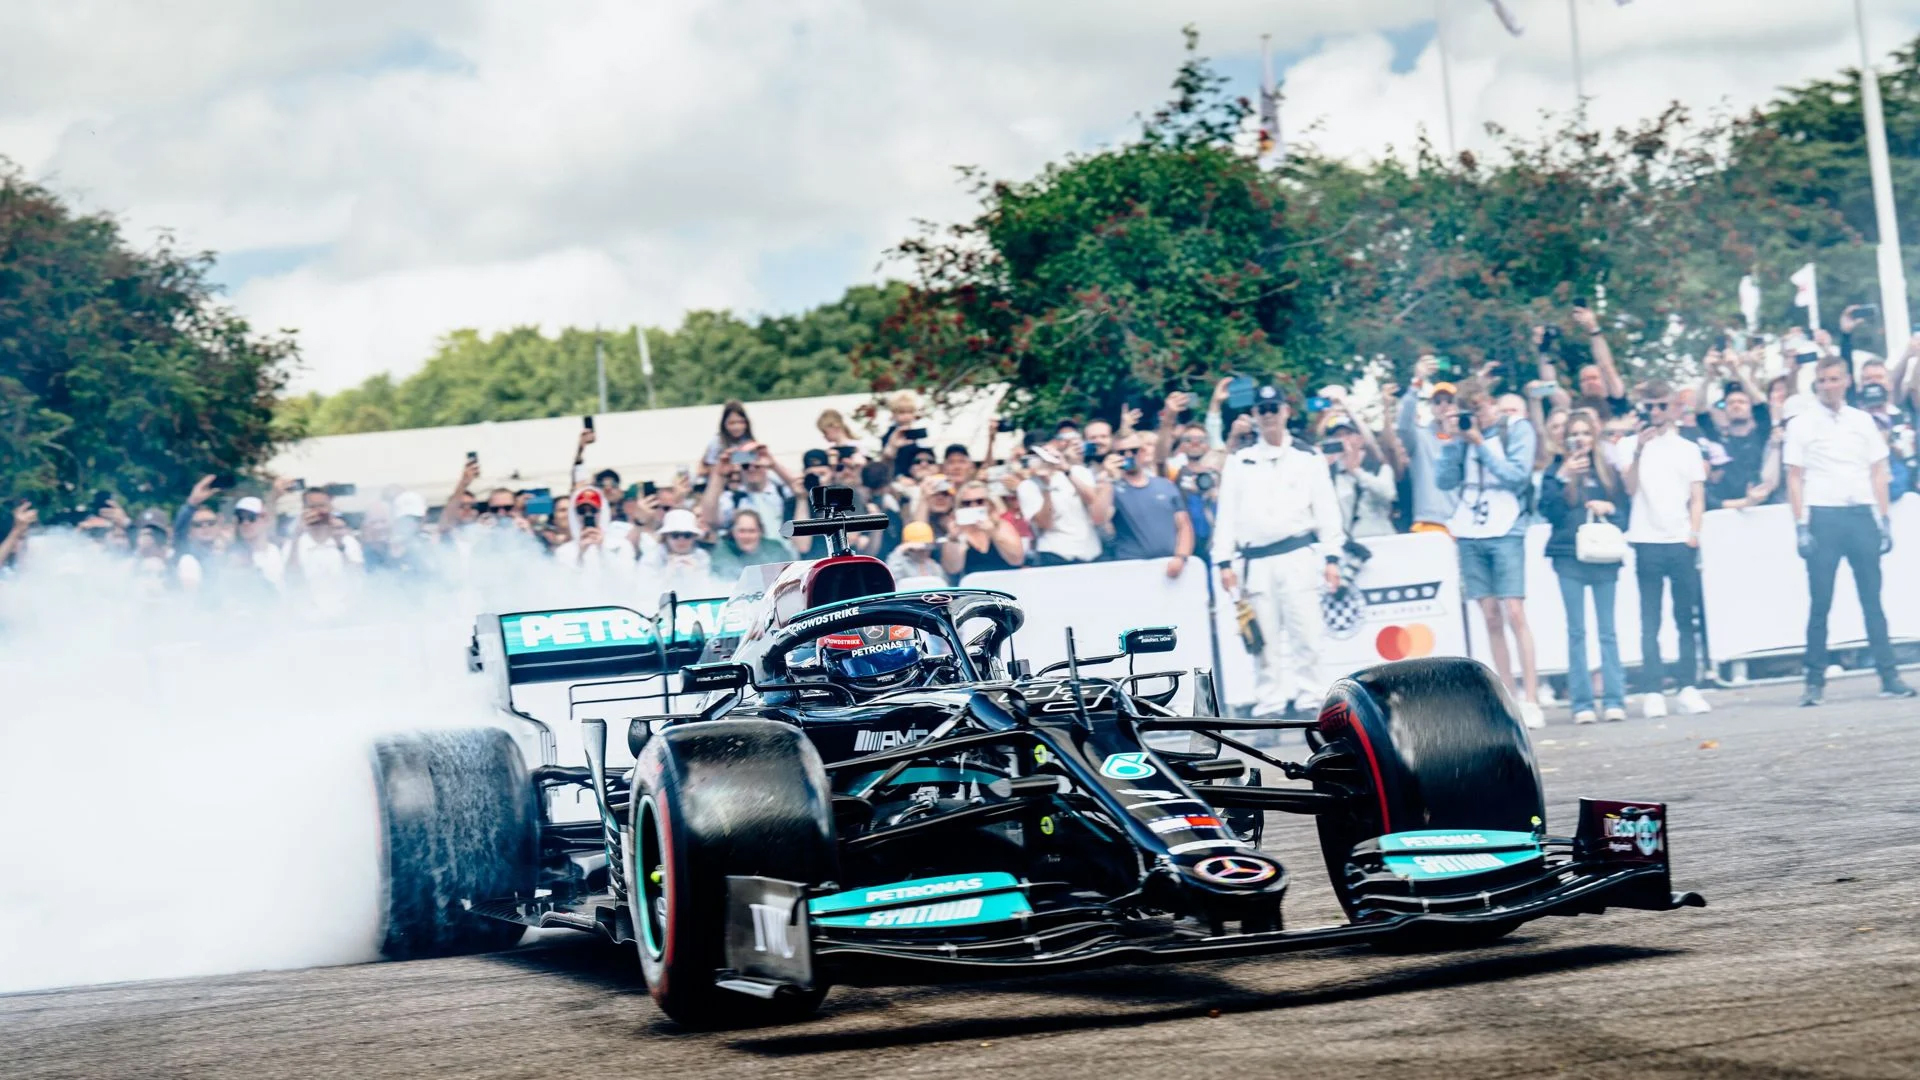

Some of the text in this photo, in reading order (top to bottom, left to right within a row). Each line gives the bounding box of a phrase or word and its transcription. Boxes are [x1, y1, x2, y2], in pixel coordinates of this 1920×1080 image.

[792, 606, 860, 632] CROWDSTRIKE
[851, 640, 903, 658] PETRONAS
[1399, 833, 1488, 847] PETRONAS
[865, 877, 984, 903] PETRONAS
